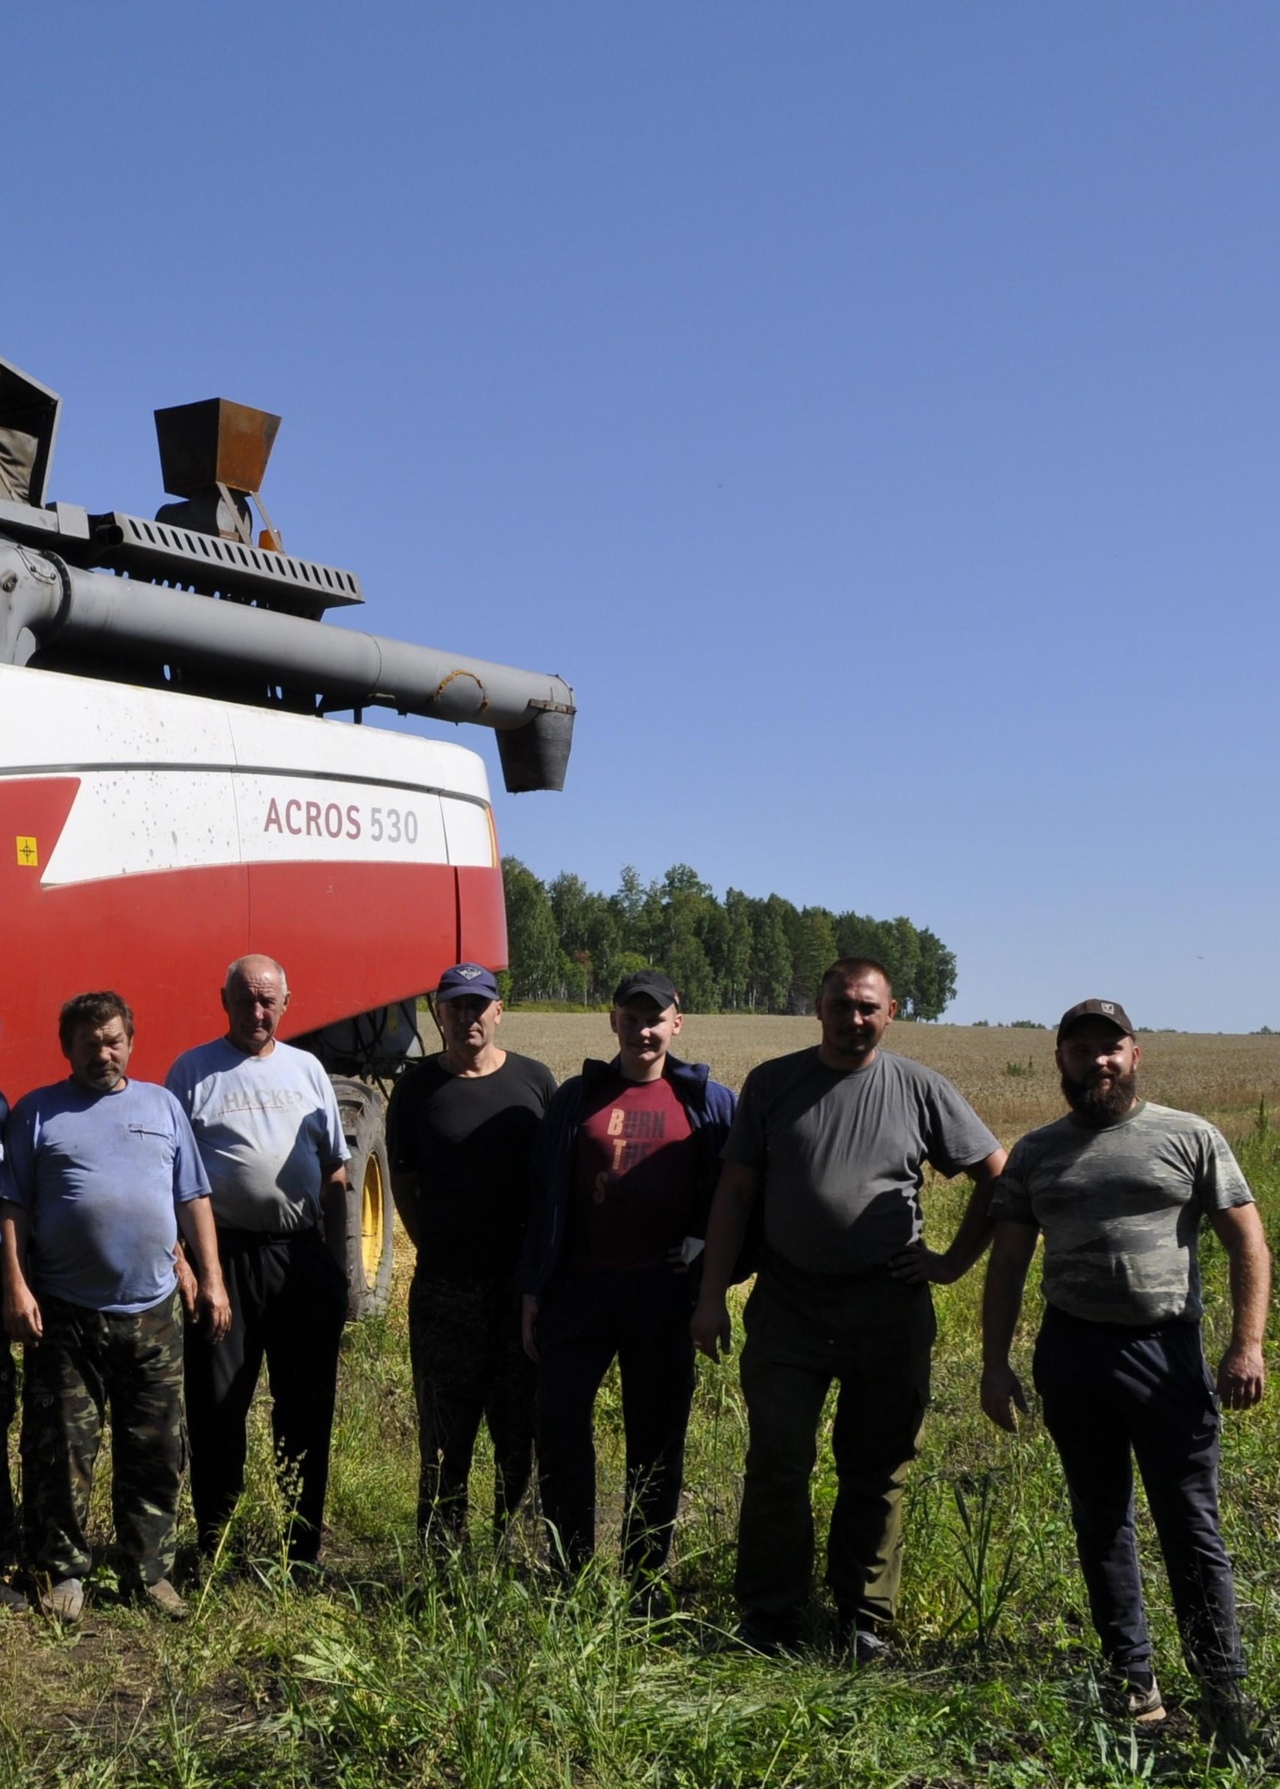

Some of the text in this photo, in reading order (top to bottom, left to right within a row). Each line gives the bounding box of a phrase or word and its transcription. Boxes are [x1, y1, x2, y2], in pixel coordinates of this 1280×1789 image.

[264, 797, 418, 844] ACROS 530
[607, 1108, 666, 1138] BURN
